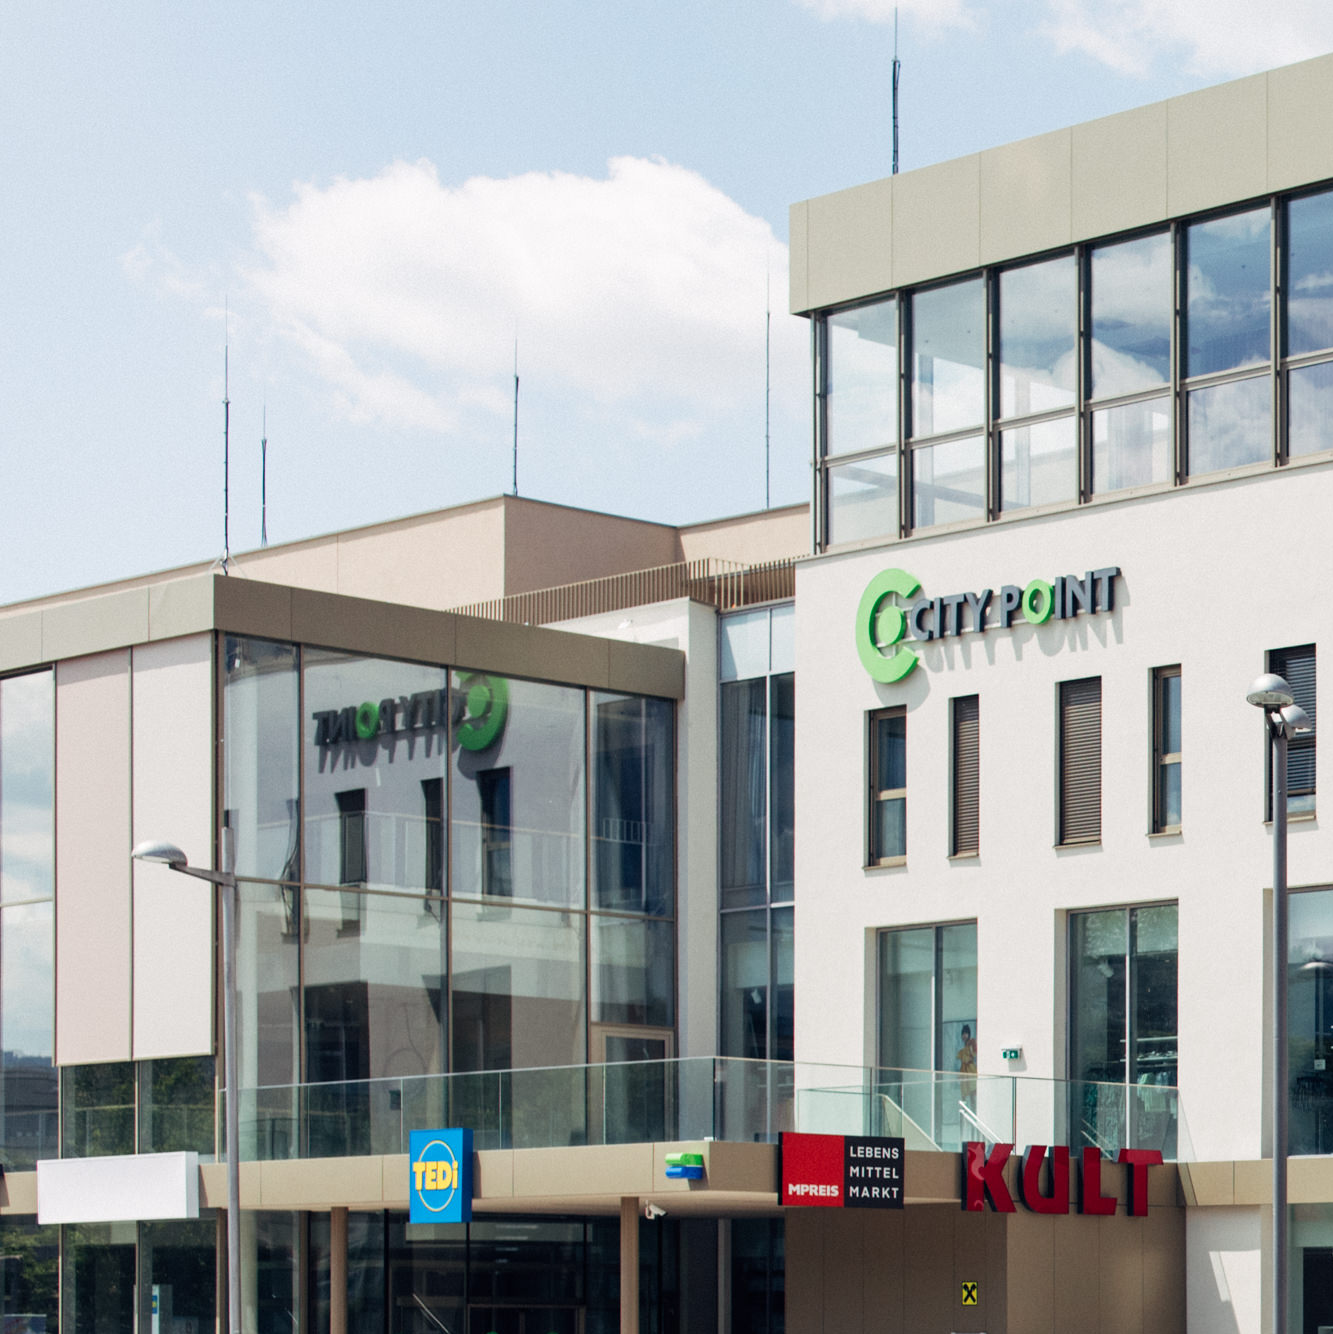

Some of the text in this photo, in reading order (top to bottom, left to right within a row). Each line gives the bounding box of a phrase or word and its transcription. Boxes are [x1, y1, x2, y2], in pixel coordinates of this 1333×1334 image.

[910, 566, 1121, 641] CITY POINT
[849, 1145, 900, 1159] LEBENS
[412, 1160, 459, 1191] TEDi
[849, 1165, 900, 1179] MITTEL
[961, 1141, 1164, 1217] KULT
[788, 1183, 839, 1197] MPREIS
[849, 1186, 899, 1199] MARKT
